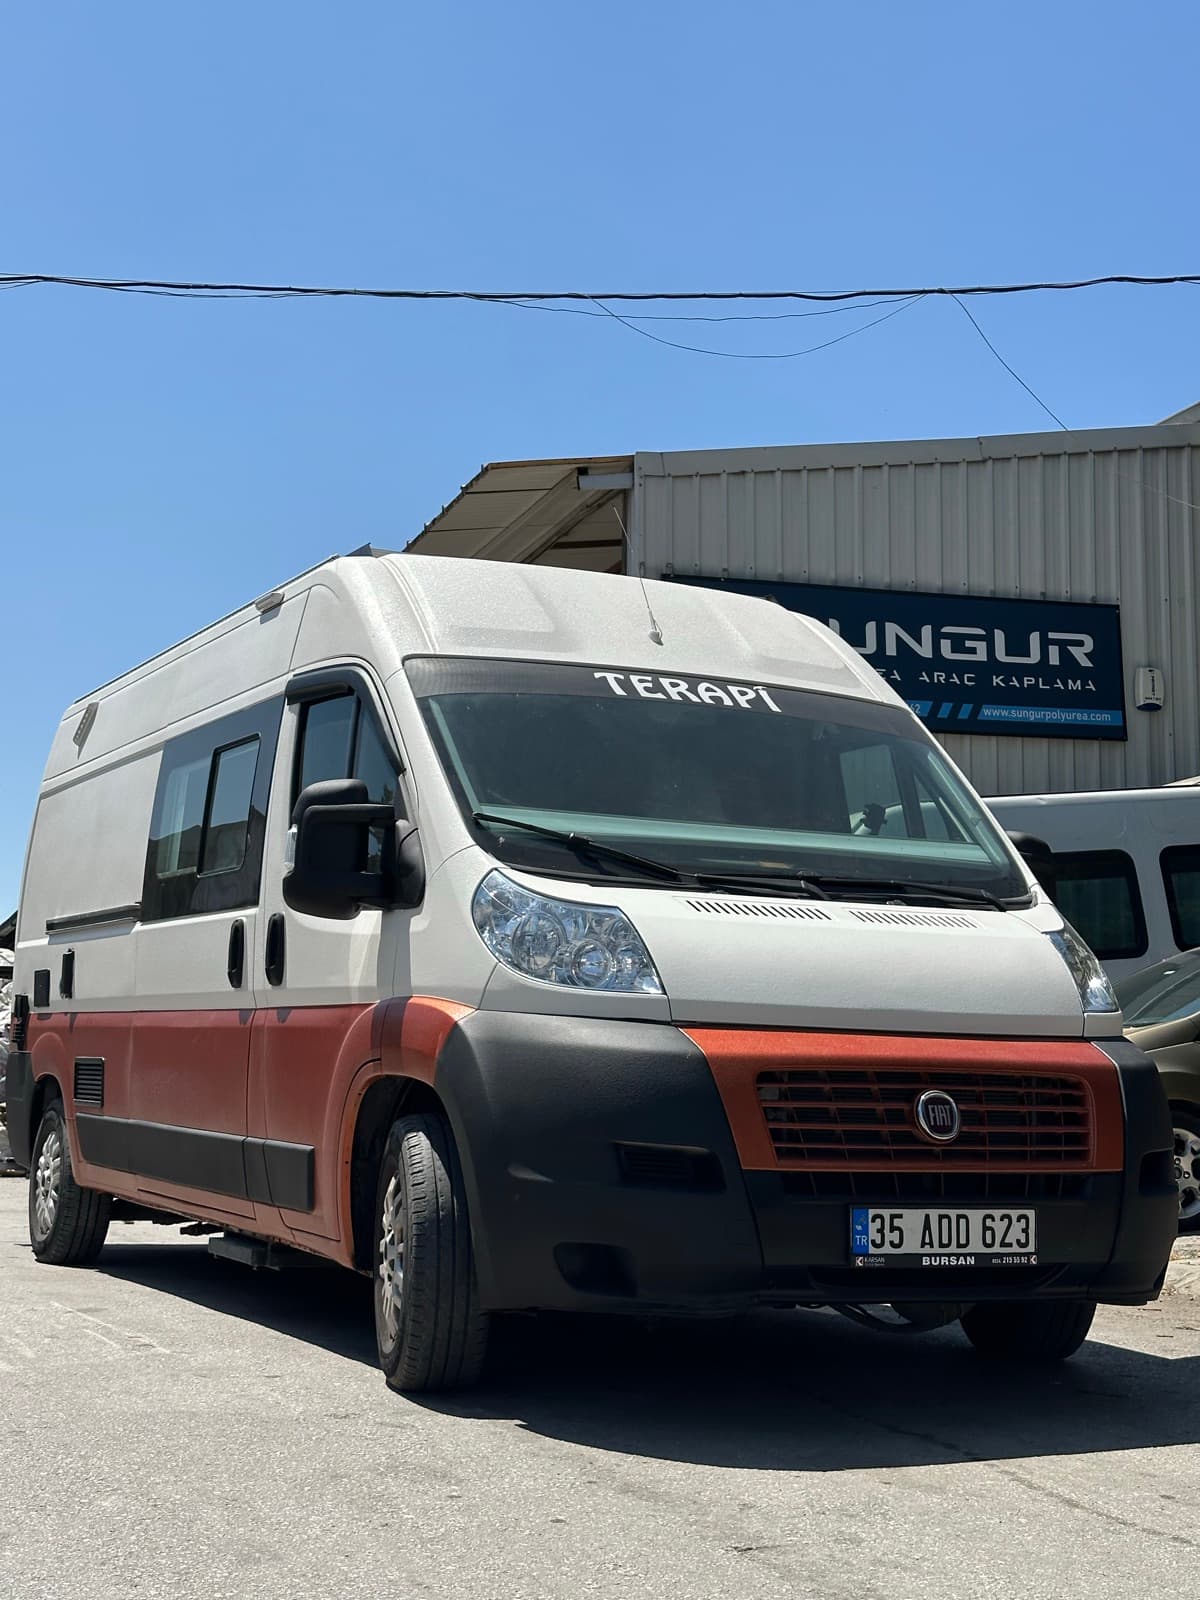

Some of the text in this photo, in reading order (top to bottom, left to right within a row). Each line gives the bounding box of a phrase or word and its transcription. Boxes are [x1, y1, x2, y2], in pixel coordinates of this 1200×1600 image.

[593, 672, 782, 713] TERAPİ
[992, 675, 1097, 691] KAPLAMA
[983, 707, 1111, 722] www.sungurpolyurea.com
[928, 1104, 952, 1127] FIAT
[855, 1213, 1031, 1249] TR 35 ADD 623
[922, 1256, 976, 1266] BURSAN
